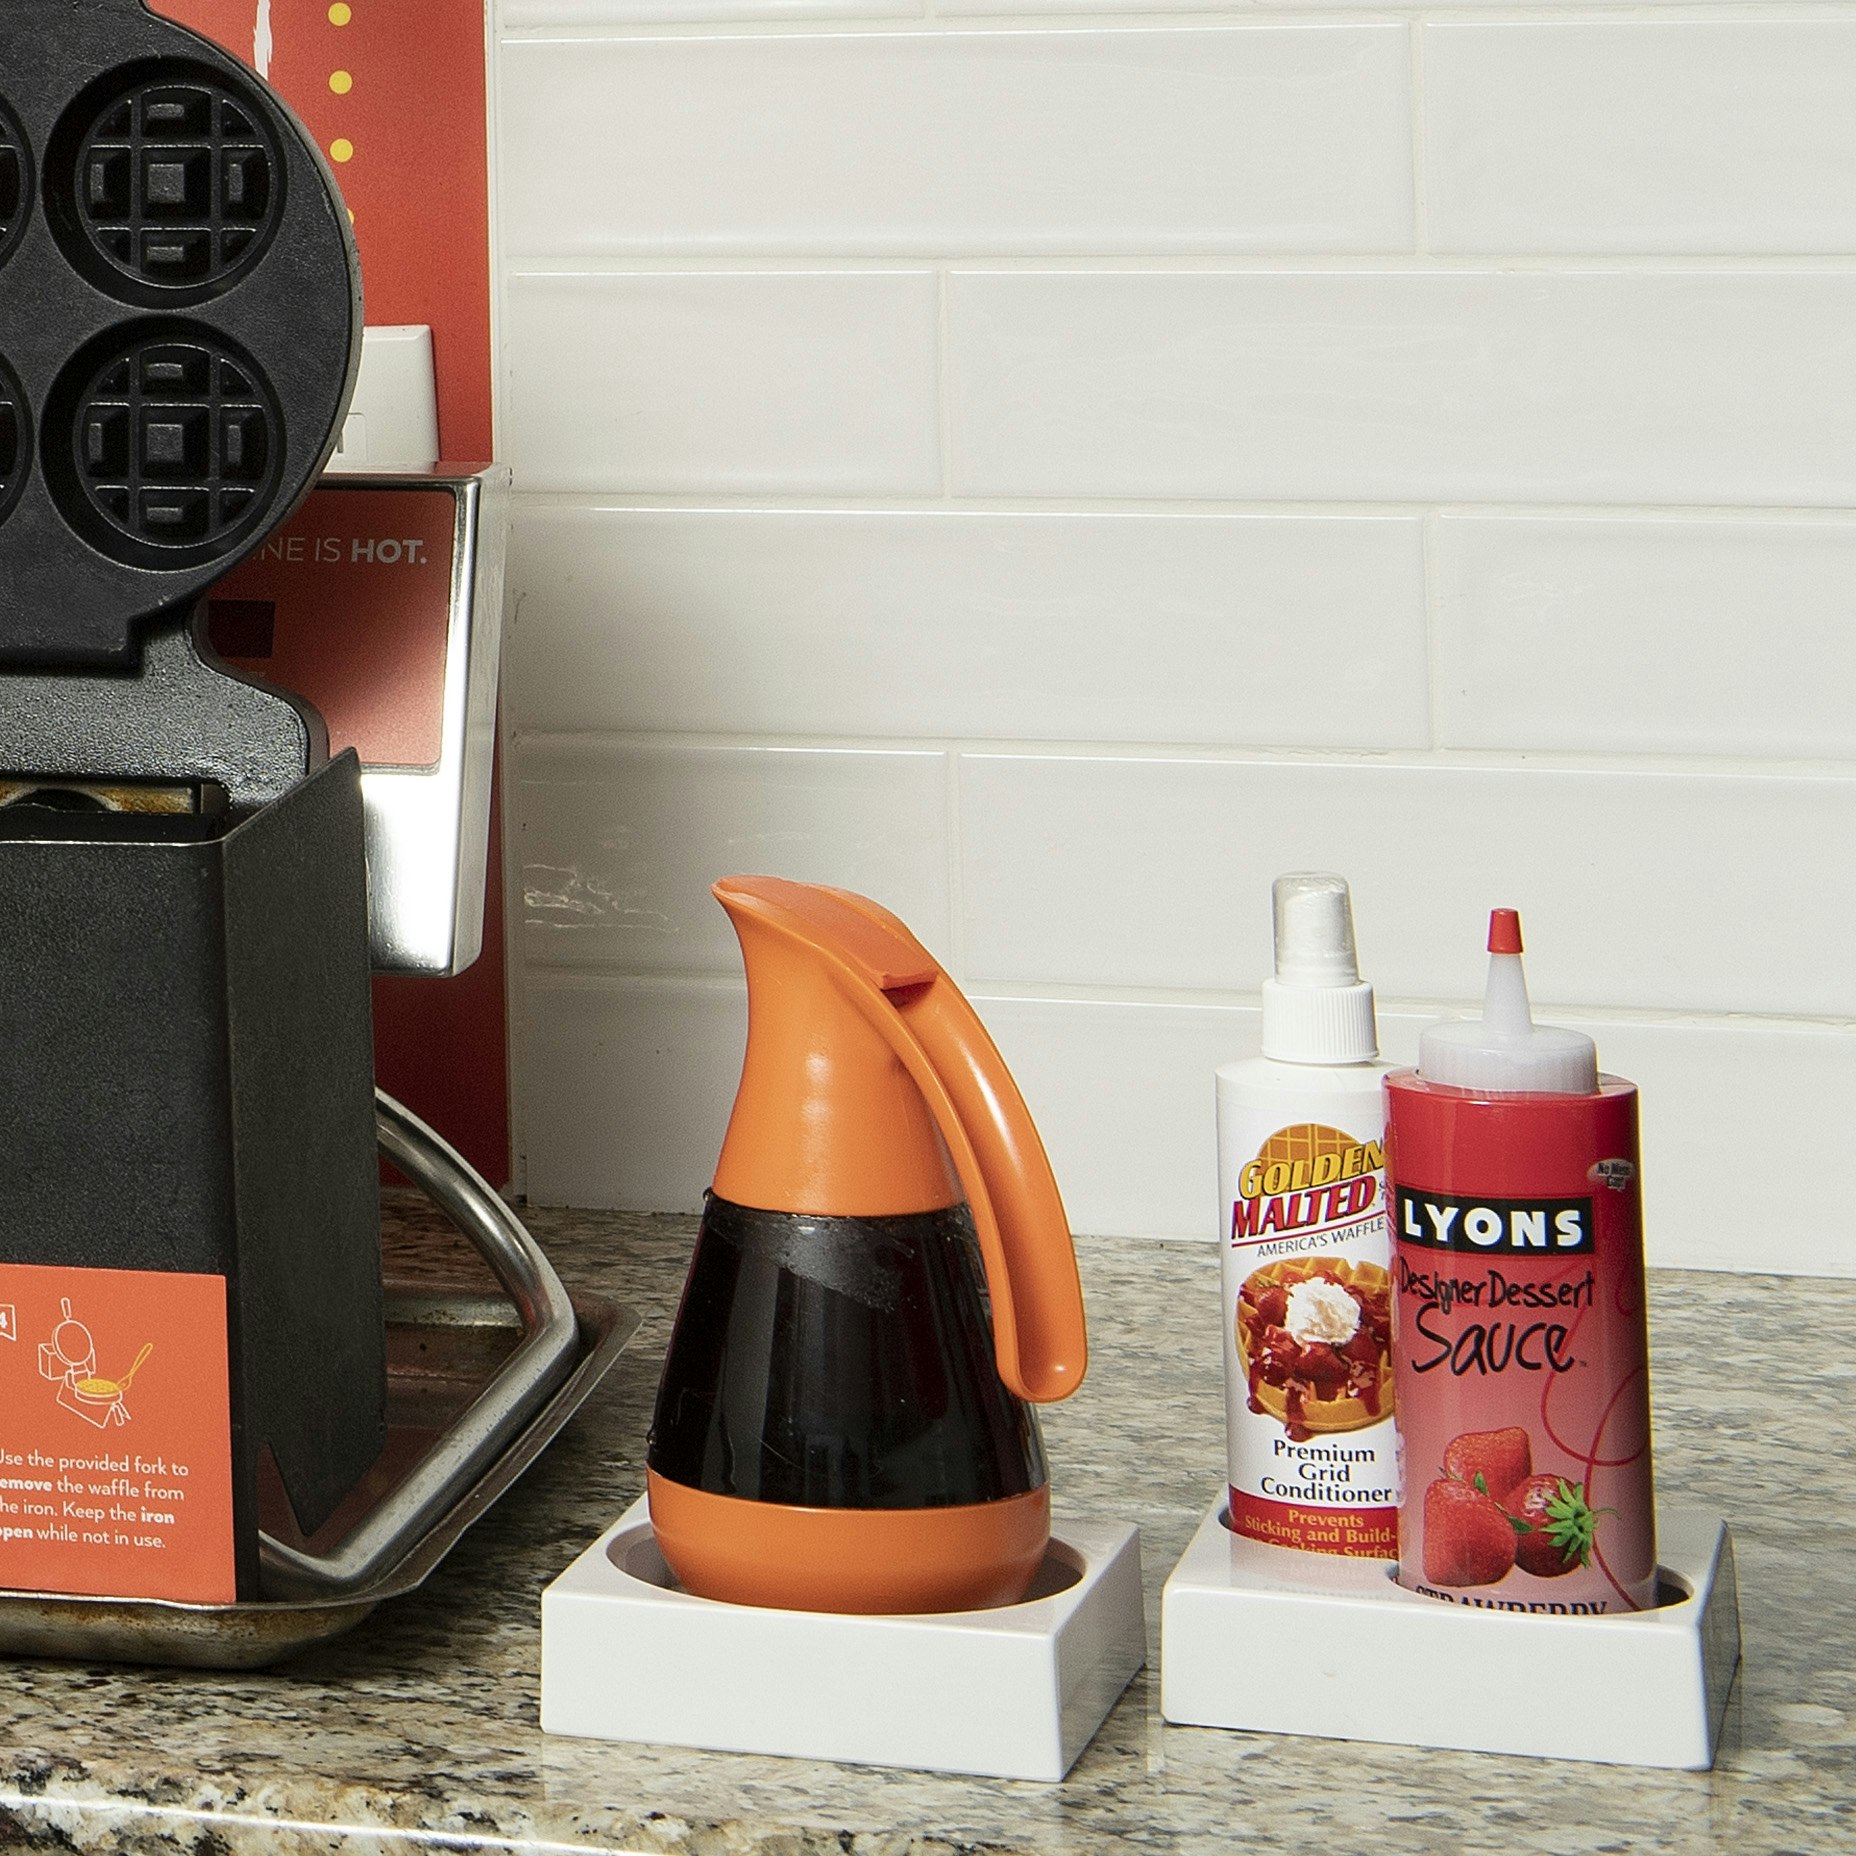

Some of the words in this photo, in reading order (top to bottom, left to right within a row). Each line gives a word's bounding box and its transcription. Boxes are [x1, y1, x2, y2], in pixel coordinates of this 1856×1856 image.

[315, 538, 342, 562] IS
[351, 538, 428, 565] HOT.
[1238, 1138, 1384, 1200] GOLDEN
[1231, 1175, 1377, 1240] MALTED
[1404, 1198, 1584, 1248] LYONS
[1257, 1233, 1328, 1258] AMERICA'S
[1331, 1216, 1385, 1244] WAFFLE
[1400, 1256, 1487, 1315] Designer
[1487, 1270, 1596, 1308] Dessert
[1411, 1301, 1575, 1376] Sauce
[27, 1449, 54, 1468] the
[59, 1454, 130, 1472] provided
[134, 1455, 167, 1475] fork
[171, 1462, 189, 1476] to
[1274, 1439, 1375, 1463] Premium
[1298, 1463, 1351, 1483] Grid
[57, 1475, 84, 1494] the
[88, 1478, 140, 1497] waffle
[144, 1480, 185, 1501] from
[1261, 1477, 1392, 1503] Conditioner
[23, 1499, 58, 1517] iron.
[63, 1501, 105, 1523] Keep
[109, 1503, 136, 1521] the
[140, 1506, 175, 1524] iron
[1288, 1509, 1365, 1528] Prevents
[37, 1523, 78, 1542] while
[82, 1525, 110, 1544] not
[114, 1529, 129, 1545] in
[133, 1532, 166, 1549] use.
[1245, 1515, 1301, 1543] Sticking
[1306, 1527, 1340, 1543] and
[1344, 1546, 1398, 1560] Surfac
